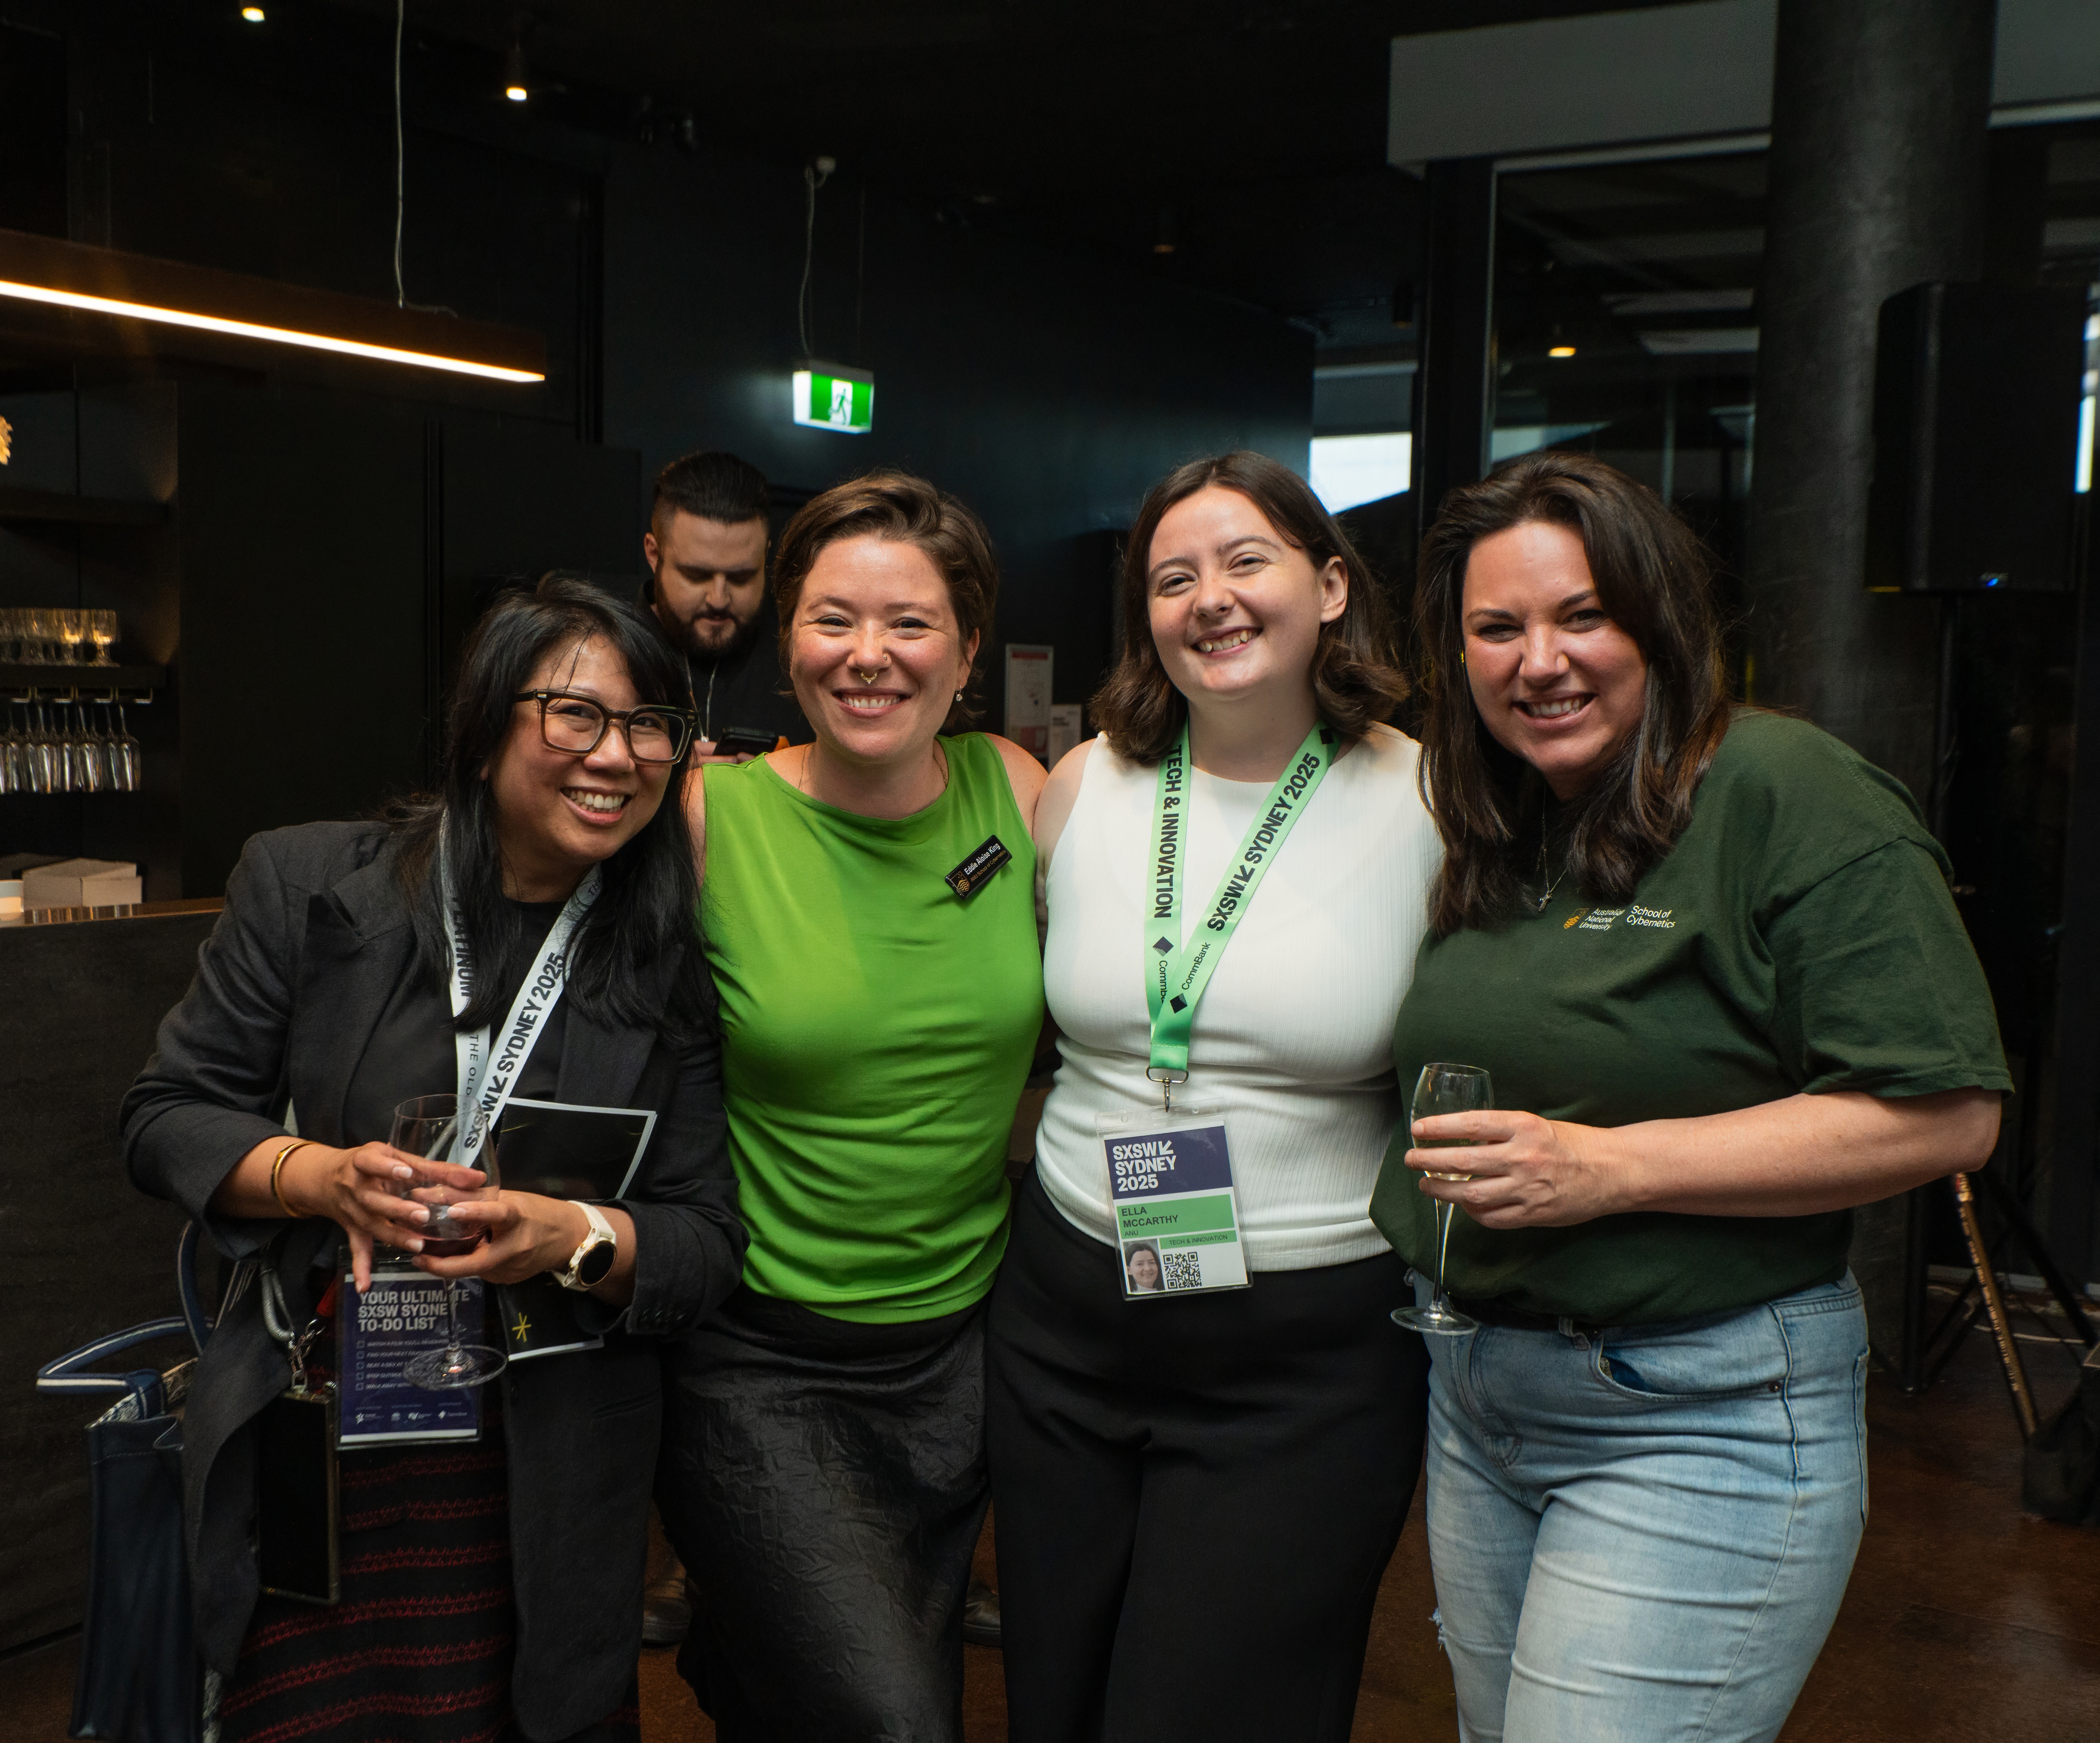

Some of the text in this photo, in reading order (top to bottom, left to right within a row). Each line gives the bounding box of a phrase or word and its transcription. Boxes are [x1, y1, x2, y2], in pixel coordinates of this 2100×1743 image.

[1154, 744, 1182, 918] TECH & INNOVATION
[1207, 752, 1320, 931] SXSW SYDNEY 2025
[964, 843, 1000, 875] Eddie Aloise King
[1631, 905, 1672, 918] School of
[1579, 922, 1612, 931] University
[1626, 915, 1676, 928] Cybernetics
[1181, 942, 1211, 990] CommBank
[497, 998, 542, 1073] SYDNEY
[531, 952, 564, 1001] 2025
[469, 1034, 479, 1062] THE
[1113, 1142, 1157, 1160] SXSW
[1115, 1155, 1176, 1176] SYDNEY
[1117, 1174, 1158, 1192] 2025
[1122, 1207, 1147, 1216] ELLA
[1123, 1215, 1178, 1228] MCCARTHY
[1191, 1234, 1228, 1243] INNOVATION
[360, 1289, 470, 1304] YOUR ULTIMTE
[358, 1303, 449, 1318] SXSW SYDNE
[358, 1317, 437, 1332] TO-DO LIST
